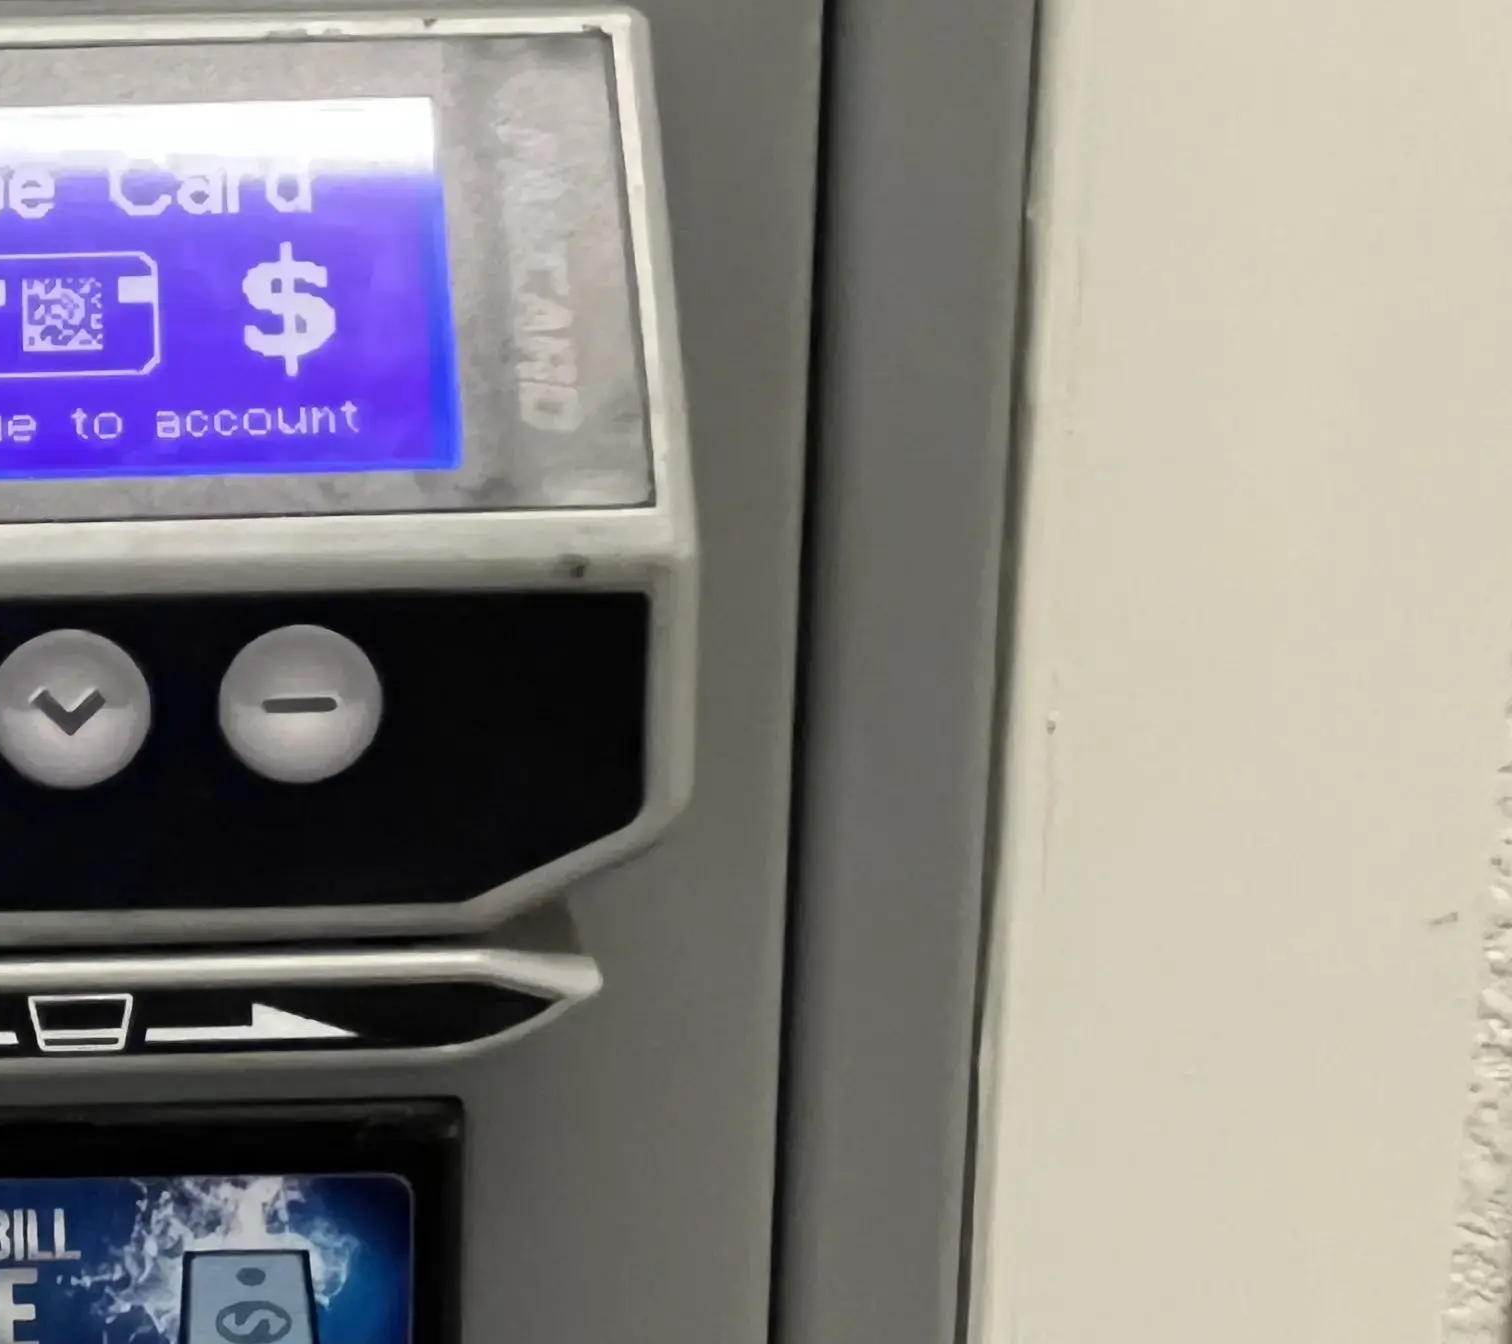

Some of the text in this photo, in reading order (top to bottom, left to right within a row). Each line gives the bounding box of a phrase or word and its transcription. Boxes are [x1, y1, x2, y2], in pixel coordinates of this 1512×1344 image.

[108, 154, 315, 217] Card
[71, 405, 124, 441] to
[155, 399, 361, 441] account
